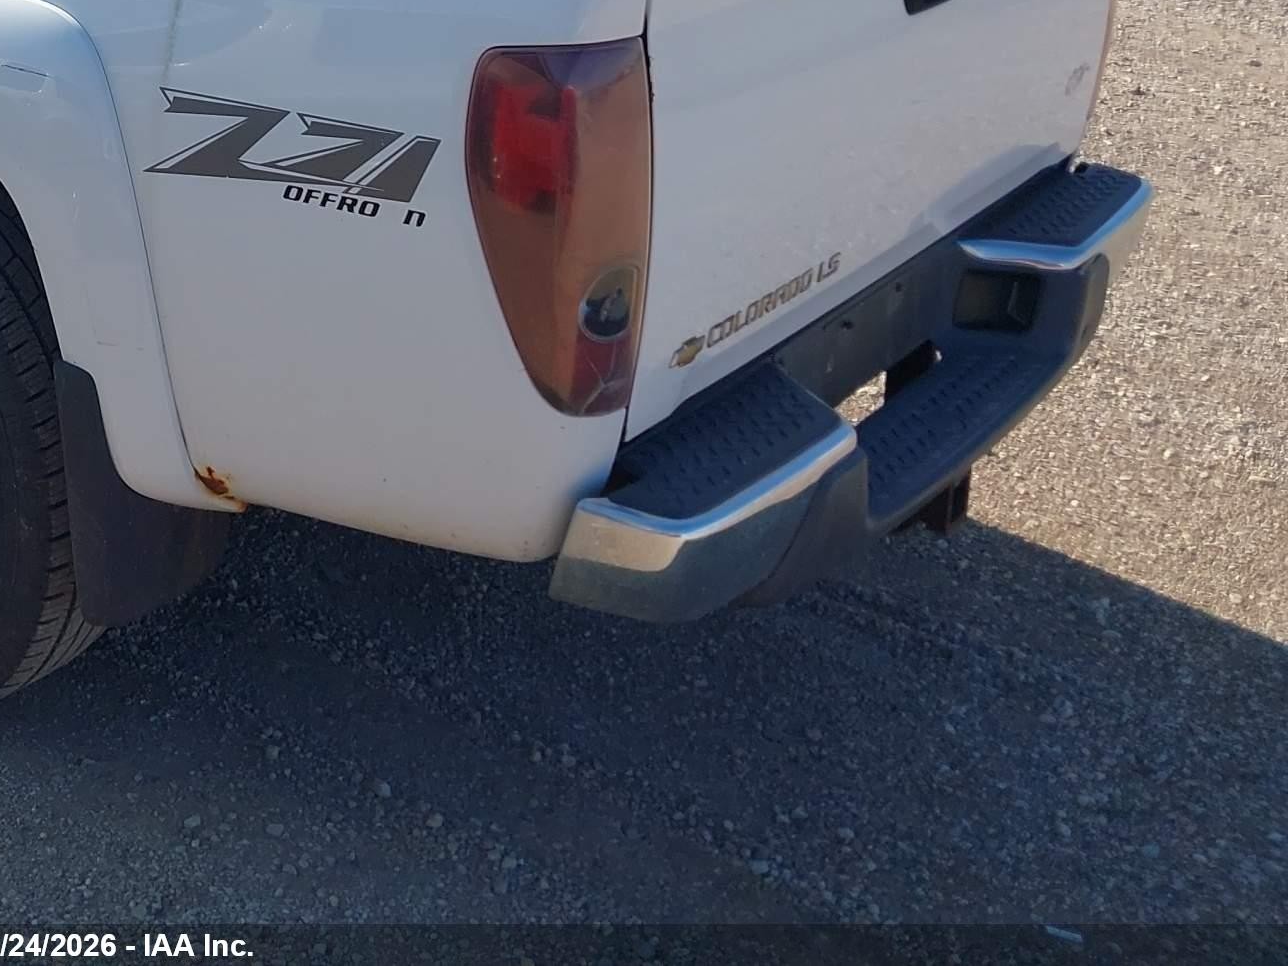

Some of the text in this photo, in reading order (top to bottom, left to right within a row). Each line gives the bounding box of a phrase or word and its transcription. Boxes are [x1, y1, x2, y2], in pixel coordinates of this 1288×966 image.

[143, 87, 441, 202] Z71
[706, 252, 841, 348] COLORADO LS
